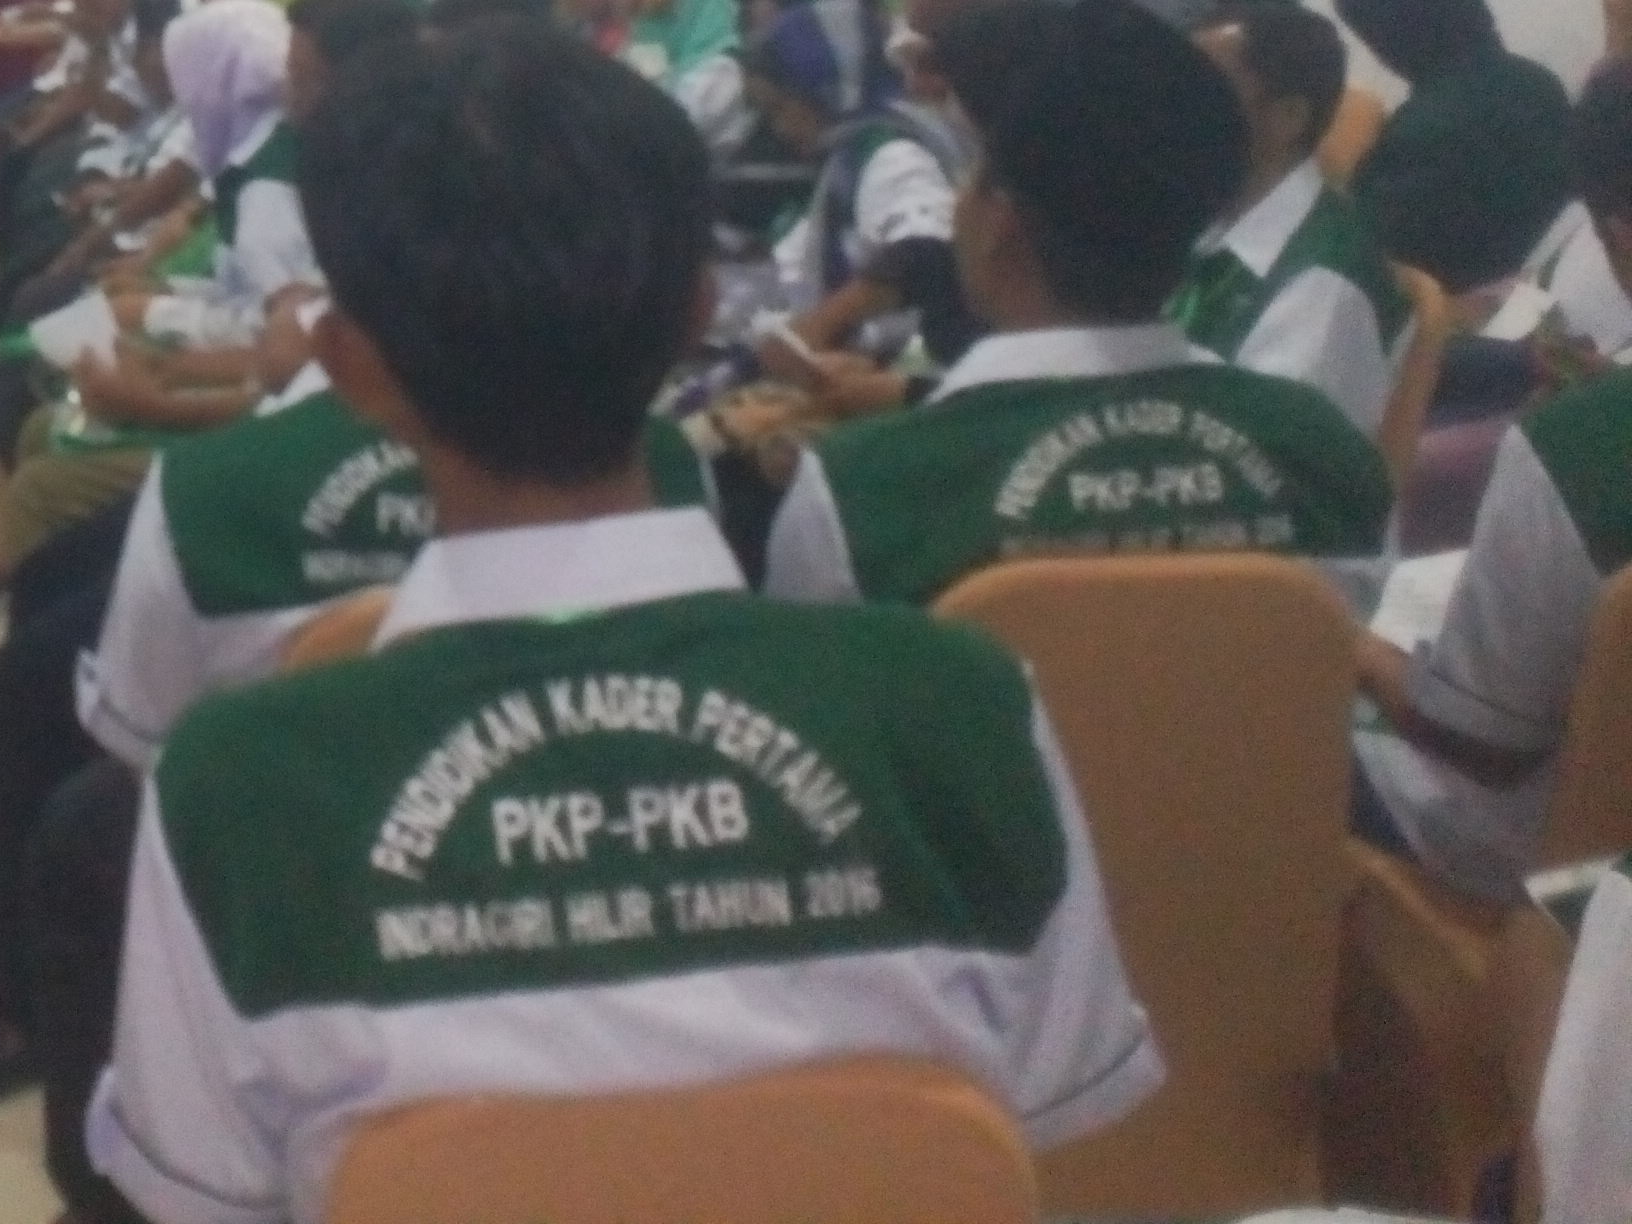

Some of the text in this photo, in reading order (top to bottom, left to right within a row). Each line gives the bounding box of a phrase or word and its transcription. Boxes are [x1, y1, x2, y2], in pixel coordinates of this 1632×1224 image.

[369, 673, 864, 880] PENDIDIKAN KADER PERTAMA
[491, 778, 750, 868] PKP-PKB
[669, 874, 794, 934] TAHUN
